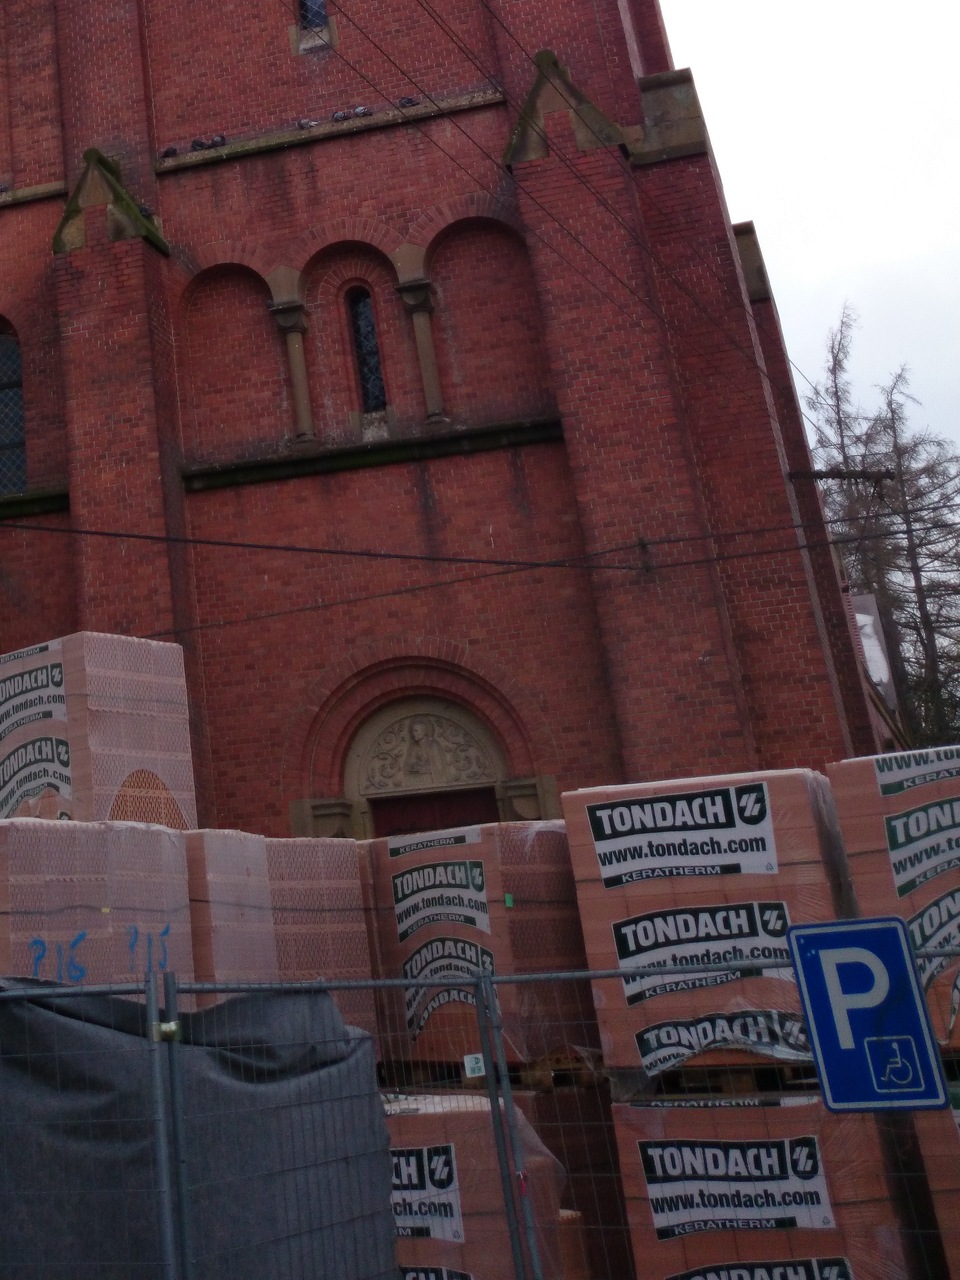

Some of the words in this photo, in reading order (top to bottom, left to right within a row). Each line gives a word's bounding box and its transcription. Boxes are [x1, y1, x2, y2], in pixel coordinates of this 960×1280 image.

[1, 711, 43, 738] KERATHERM
[596, 795, 727, 835] TONDACH
[399, 837, 455, 854] KERATHERM
[597, 836, 767, 866] www.tondach.com
[394, 864, 467, 899] TONDACH
[622, 865, 721, 883] KERATHERM
[396, 894, 488, 925] www.tondach.com
[407, 911, 465, 935] KERATHERM
[621, 909, 751, 952] TONDACH
[645, 971, 742, 998] KERATHERM
[818, 946, 890, 1050] P
[647, 1147, 780, 1177] TONDACH
[650, 1188, 821, 1214] www.tondach.com
[674, 1219, 776, 1236] KERATHERM
